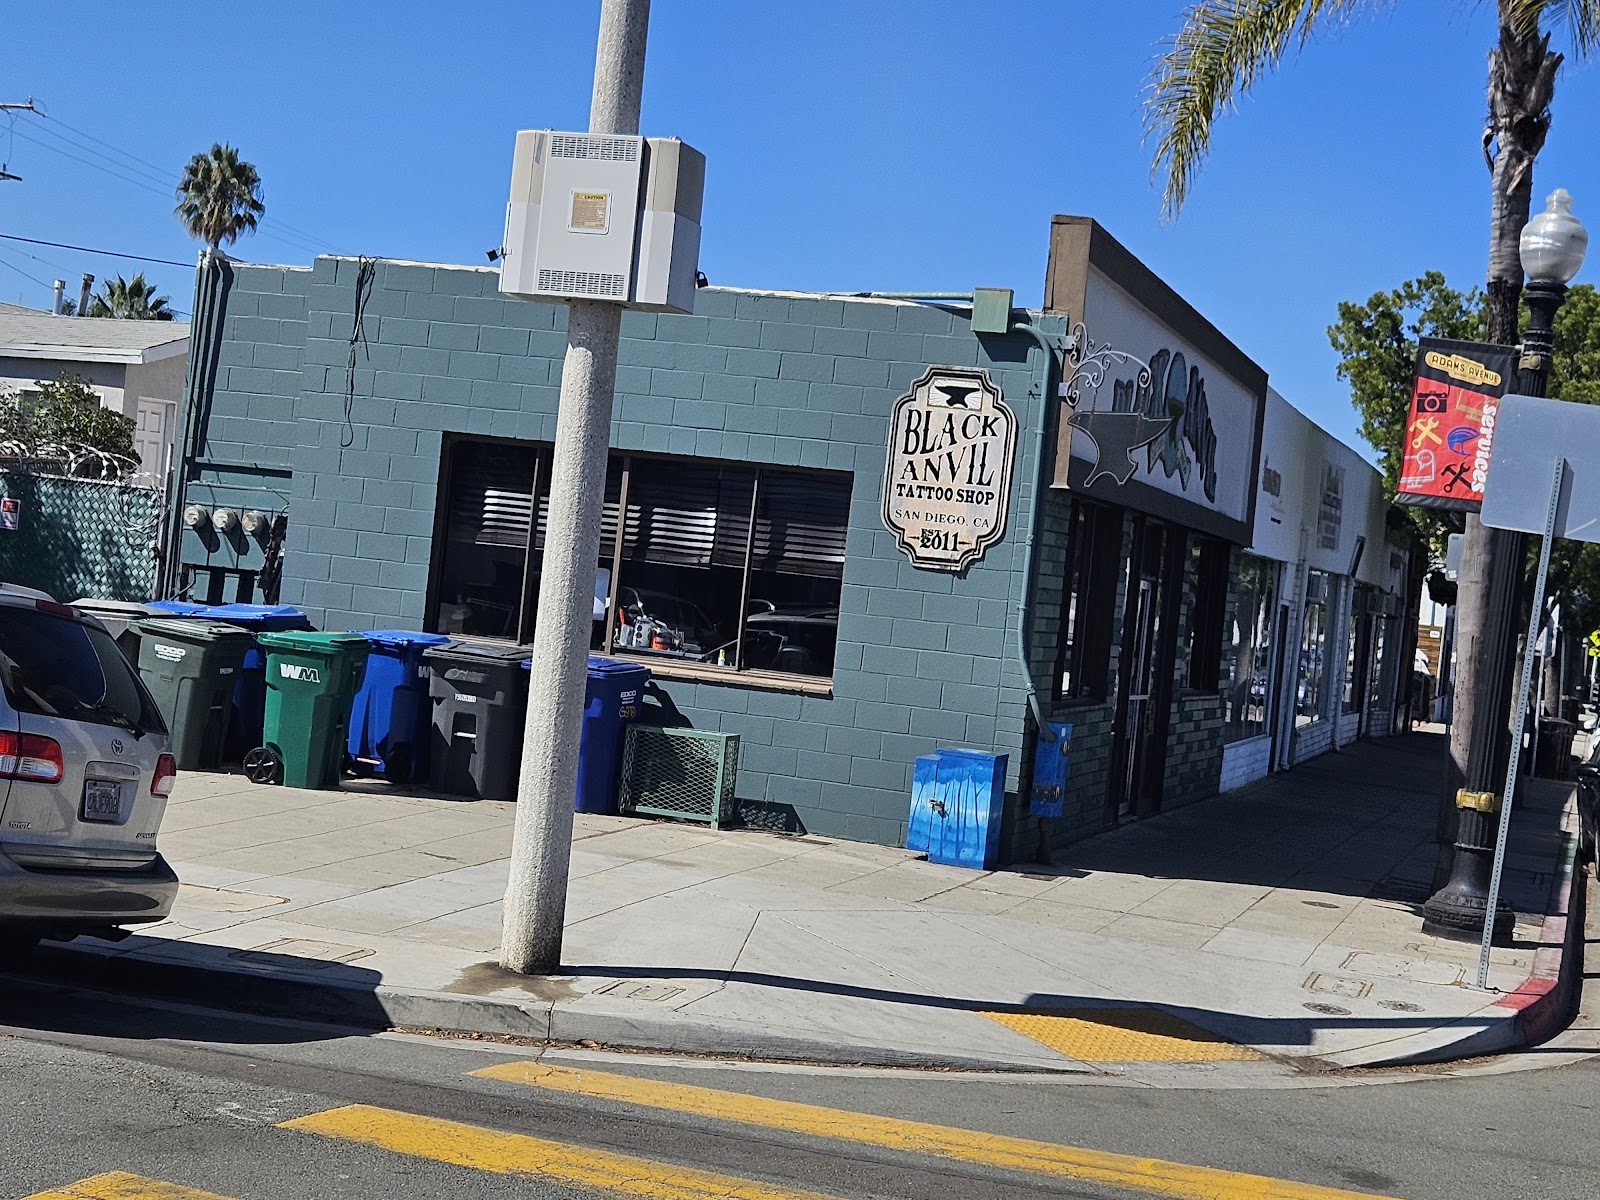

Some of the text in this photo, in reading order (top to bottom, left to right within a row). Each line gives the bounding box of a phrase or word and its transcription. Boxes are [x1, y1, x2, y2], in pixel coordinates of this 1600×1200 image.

[1432, 354, 1465, 372] ADAMS
[1468, 366, 1499, 383] AVENUE
[902, 408, 1001, 455] BLACK
[900, 441, 995, 487] ANVIL
[896, 483, 995, 506] TATTOO SHOP
[895, 508, 921, 521] SAN
[973, 518, 990, 529] CA
[920, 534, 960, 552] 2011
[280, 663, 320, 684] WM
[418, 666, 431, 678] W
[620, 690, 636, 698] EDCO
